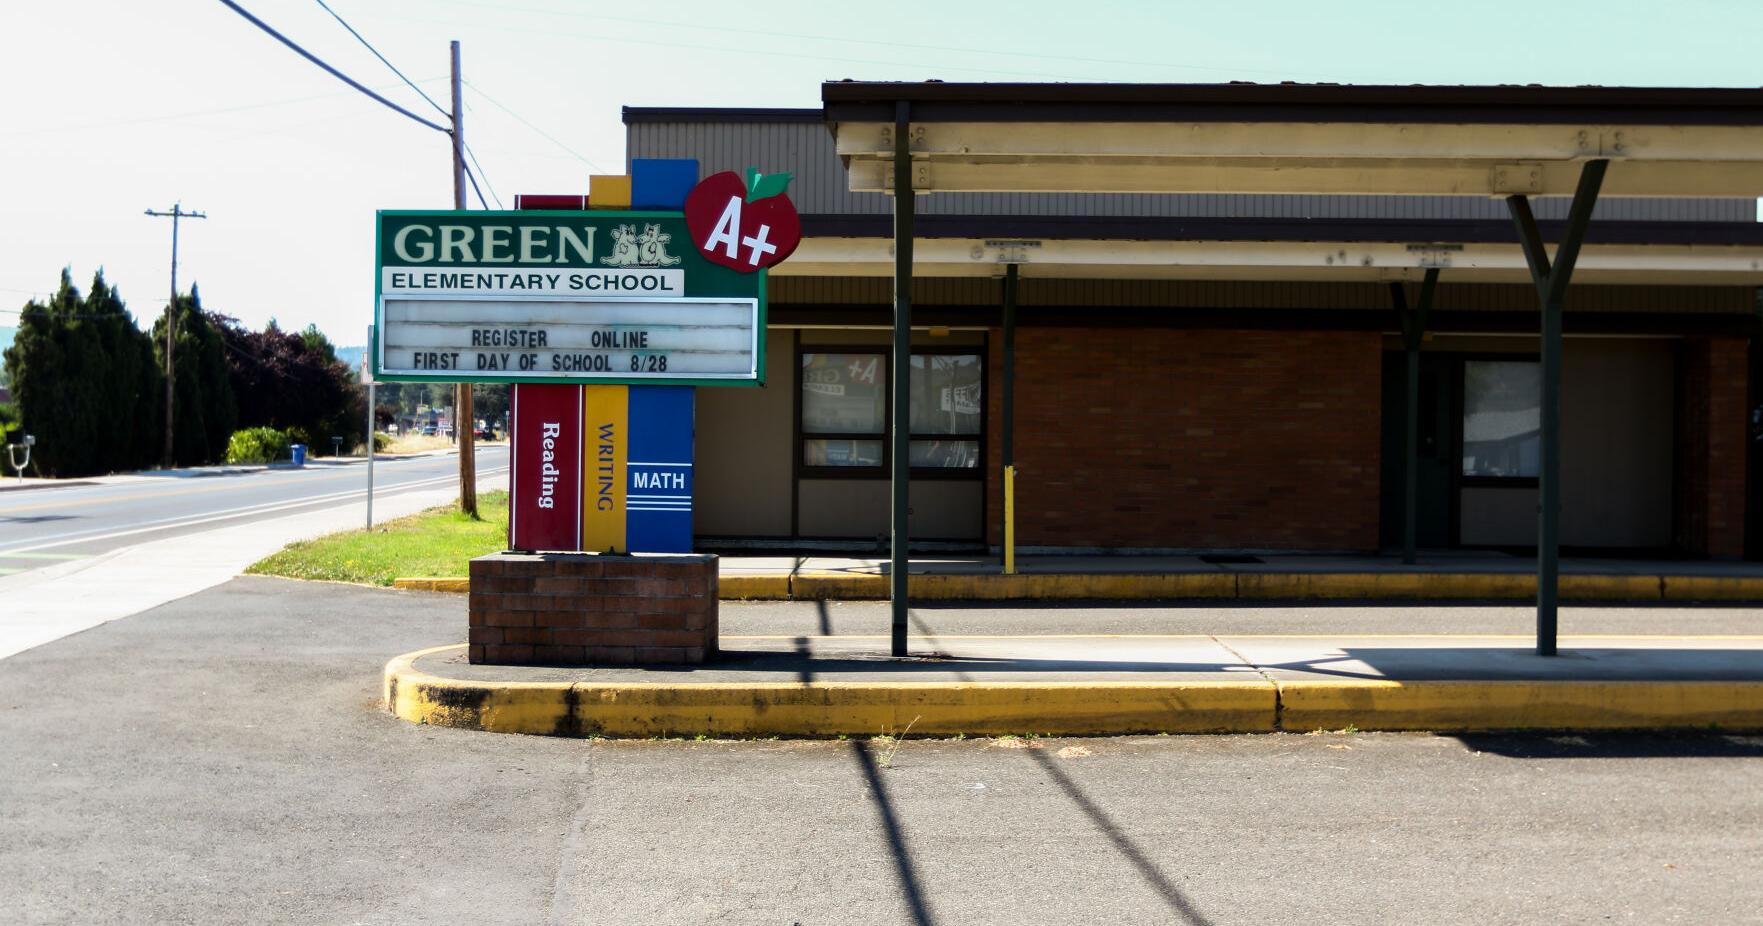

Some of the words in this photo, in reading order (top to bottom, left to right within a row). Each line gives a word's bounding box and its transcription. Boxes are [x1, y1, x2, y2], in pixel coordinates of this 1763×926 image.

[394, 224, 597, 264] GREEN
[703, 195, 777, 267] A+
[392, 272, 560, 290] ELEMENTARY
[569, 274, 674, 291] SCHOOL
[471, 329, 548, 348] REGISTER
[591, 330, 648, 348] ONLINE
[413, 352, 459, 370] FIRST
[477, 353, 510, 371] DAY
[519, 353, 538, 371] OF
[552, 354, 612, 372] SCHOOL
[630, 355, 667, 372] 8/28
[538, 422, 560, 509] Reading
[597, 423, 614, 511] WRITING
[633, 472, 685, 489] MATH
